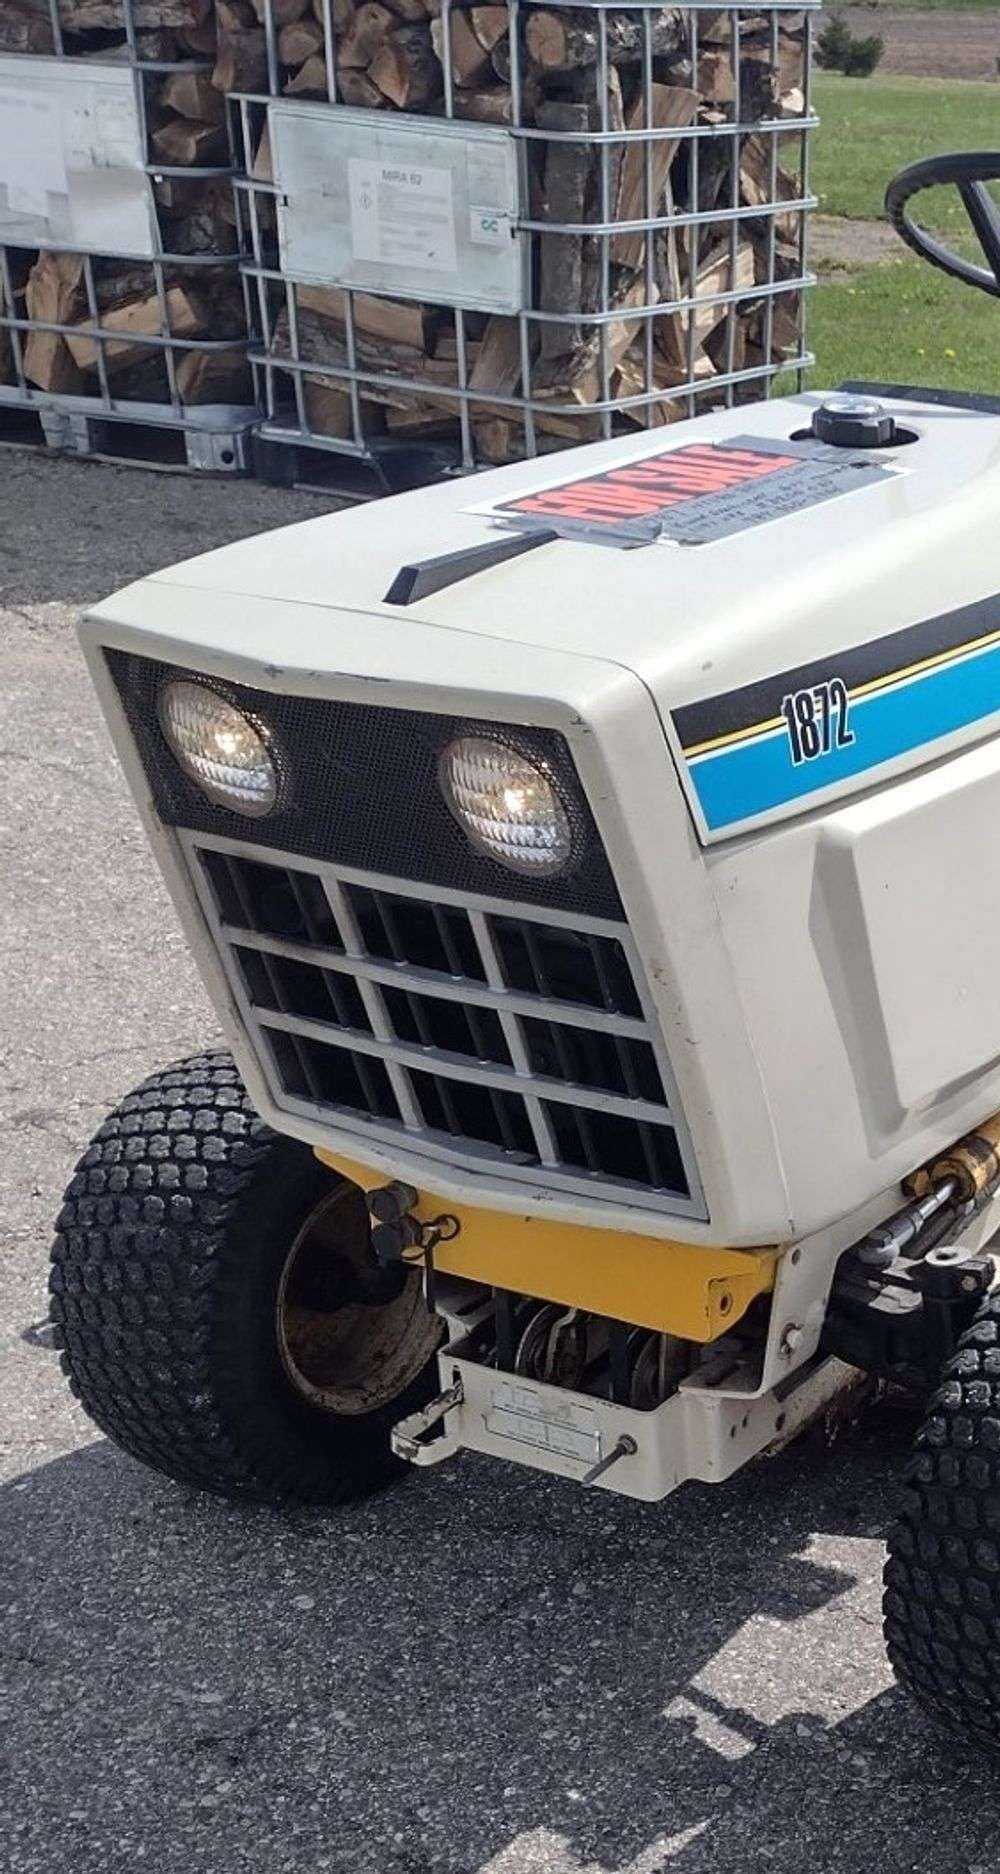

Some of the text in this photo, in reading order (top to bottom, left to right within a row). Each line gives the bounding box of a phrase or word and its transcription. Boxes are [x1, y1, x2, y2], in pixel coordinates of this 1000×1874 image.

[381, 169, 408, 183] MIRA
[507, 481, 692, 524] FOR
[606, 445, 806, 491] SALE
[782, 678, 856, 766] 1872
